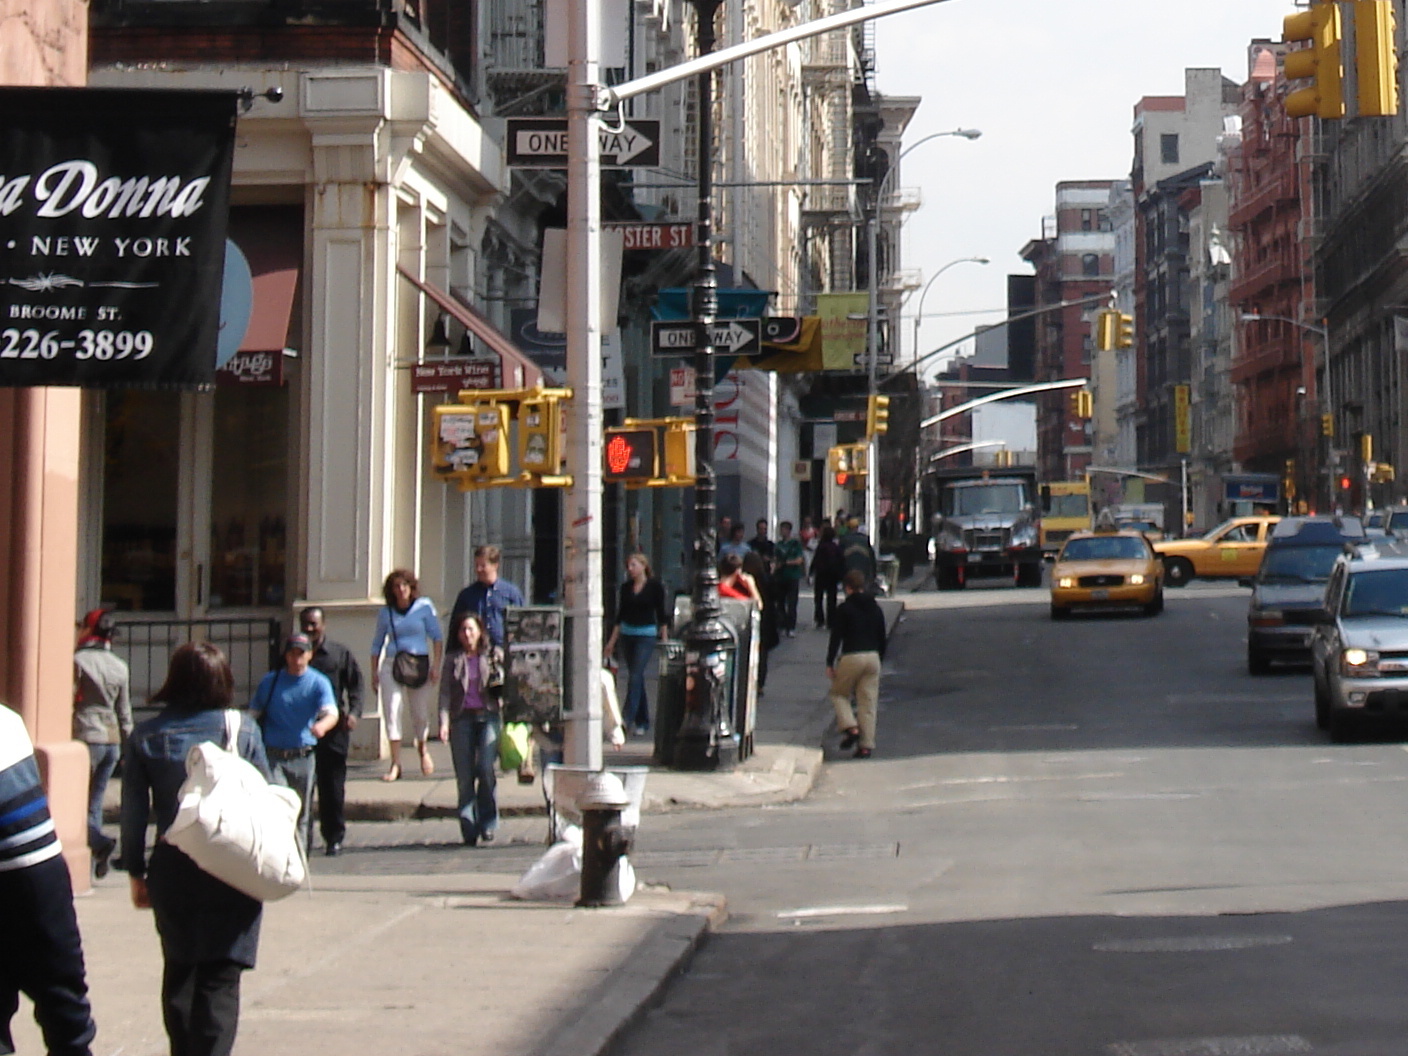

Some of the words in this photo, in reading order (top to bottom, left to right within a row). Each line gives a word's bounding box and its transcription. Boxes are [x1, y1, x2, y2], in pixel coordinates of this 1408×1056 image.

[529, 134, 568, 152] ONE
[35, 159, 211, 218] Donna
[31, 235, 99, 257] NEW
[114, 236, 192, 257] YORK
[670, 226, 687, 247] ST
[10, 304, 87, 320] BROOME
[97, 306, 122, 320] ST.
[667, 332, 695, 346] ONE
[714, 331, 743, 345] WAY
